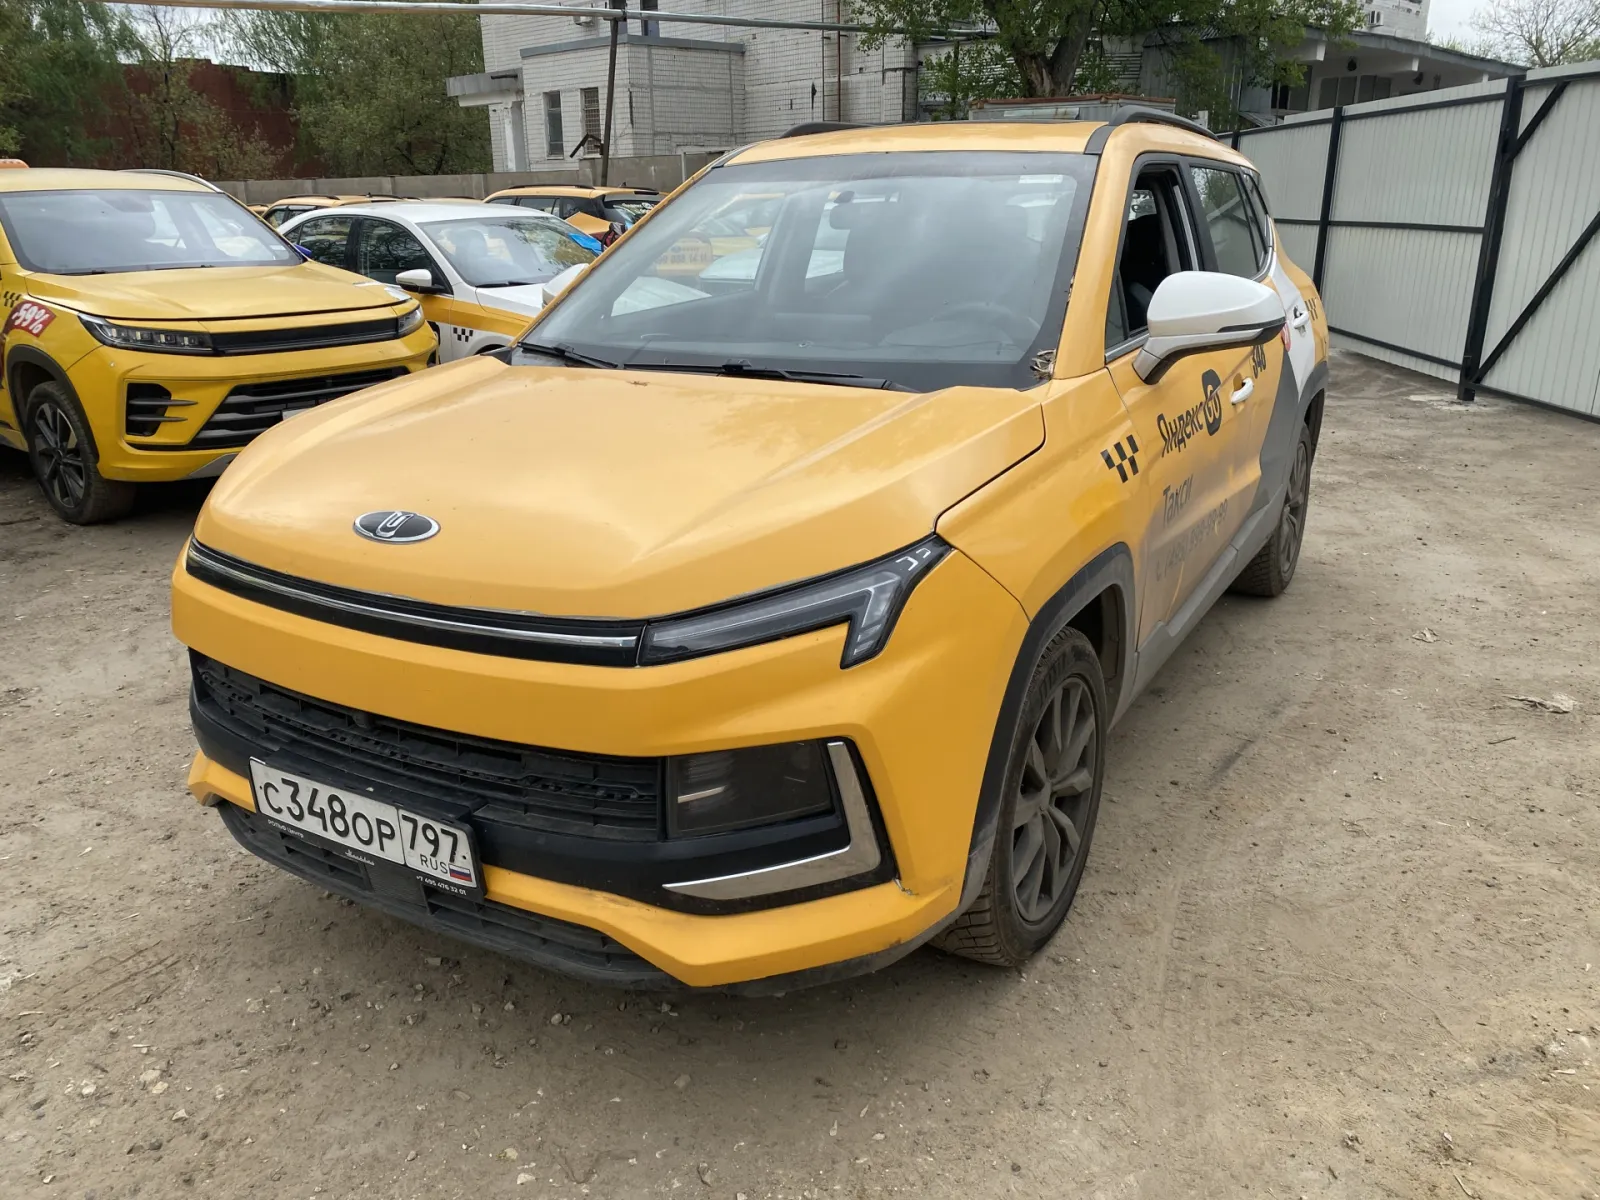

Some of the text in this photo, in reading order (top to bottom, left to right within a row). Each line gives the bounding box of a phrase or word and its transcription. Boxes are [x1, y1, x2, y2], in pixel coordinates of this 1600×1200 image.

[1157, 401, 1203, 458] Яндекс
[1163, 473, 1193, 530] Такси
[402, 814, 459, 863] 797
[420, 853, 448, 874] RUS
